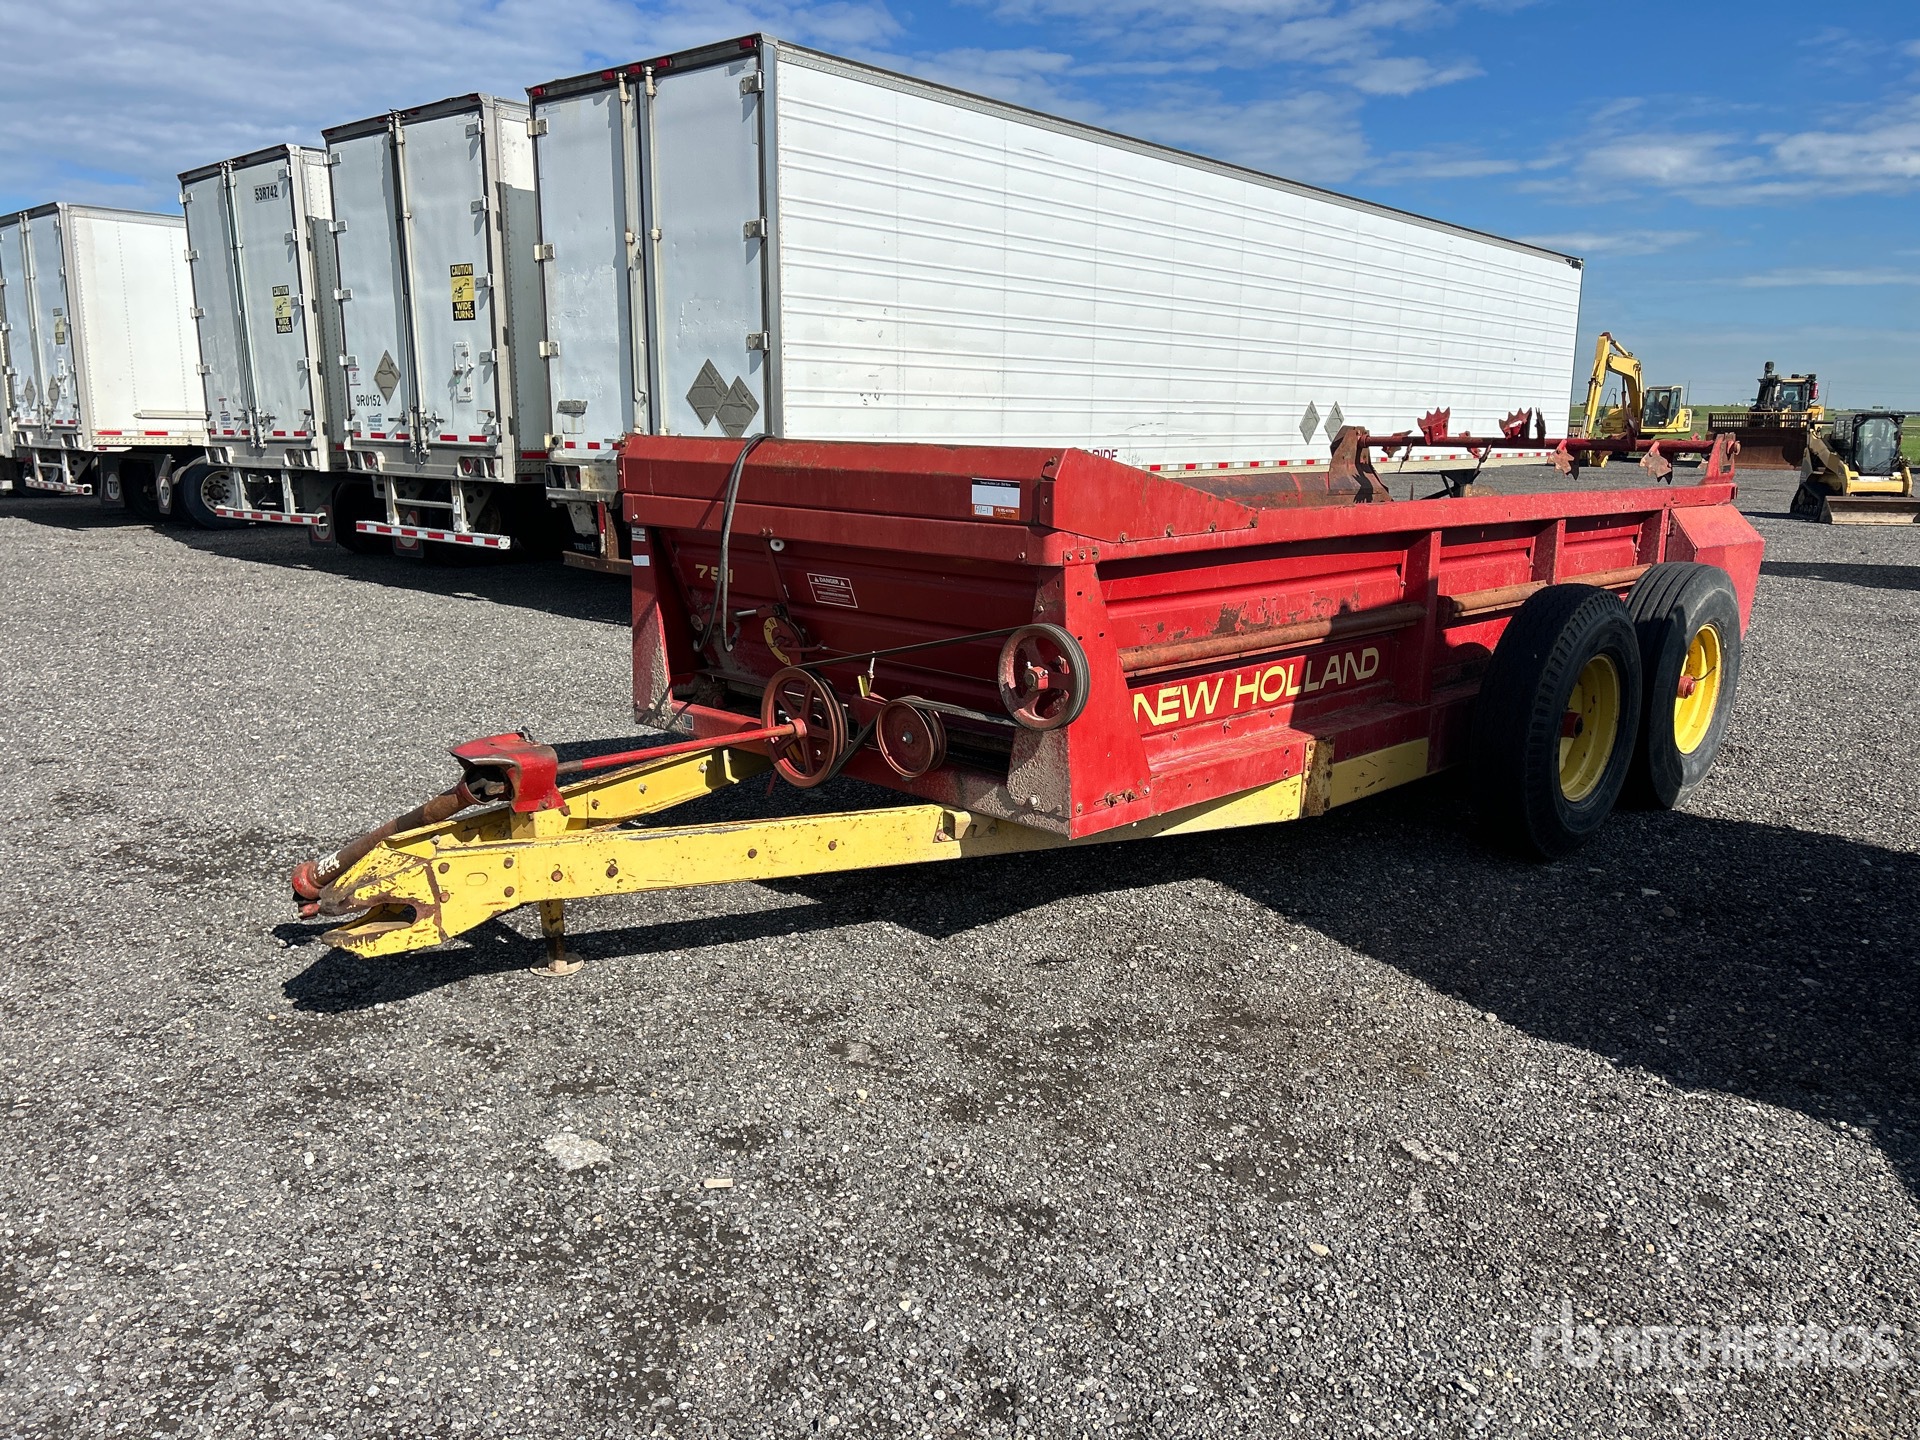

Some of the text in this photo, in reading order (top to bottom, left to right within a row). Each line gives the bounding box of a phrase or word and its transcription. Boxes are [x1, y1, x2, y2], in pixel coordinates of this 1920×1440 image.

[254, 184, 279, 201] 53R742
[451, 264, 473, 276] CAUTION
[456, 301, 472, 311] WIDE
[454, 310, 474, 320] TURNS
[355, 394, 382, 407] 9R0152
[1133, 647, 1380, 726] NEW HOLLAND
